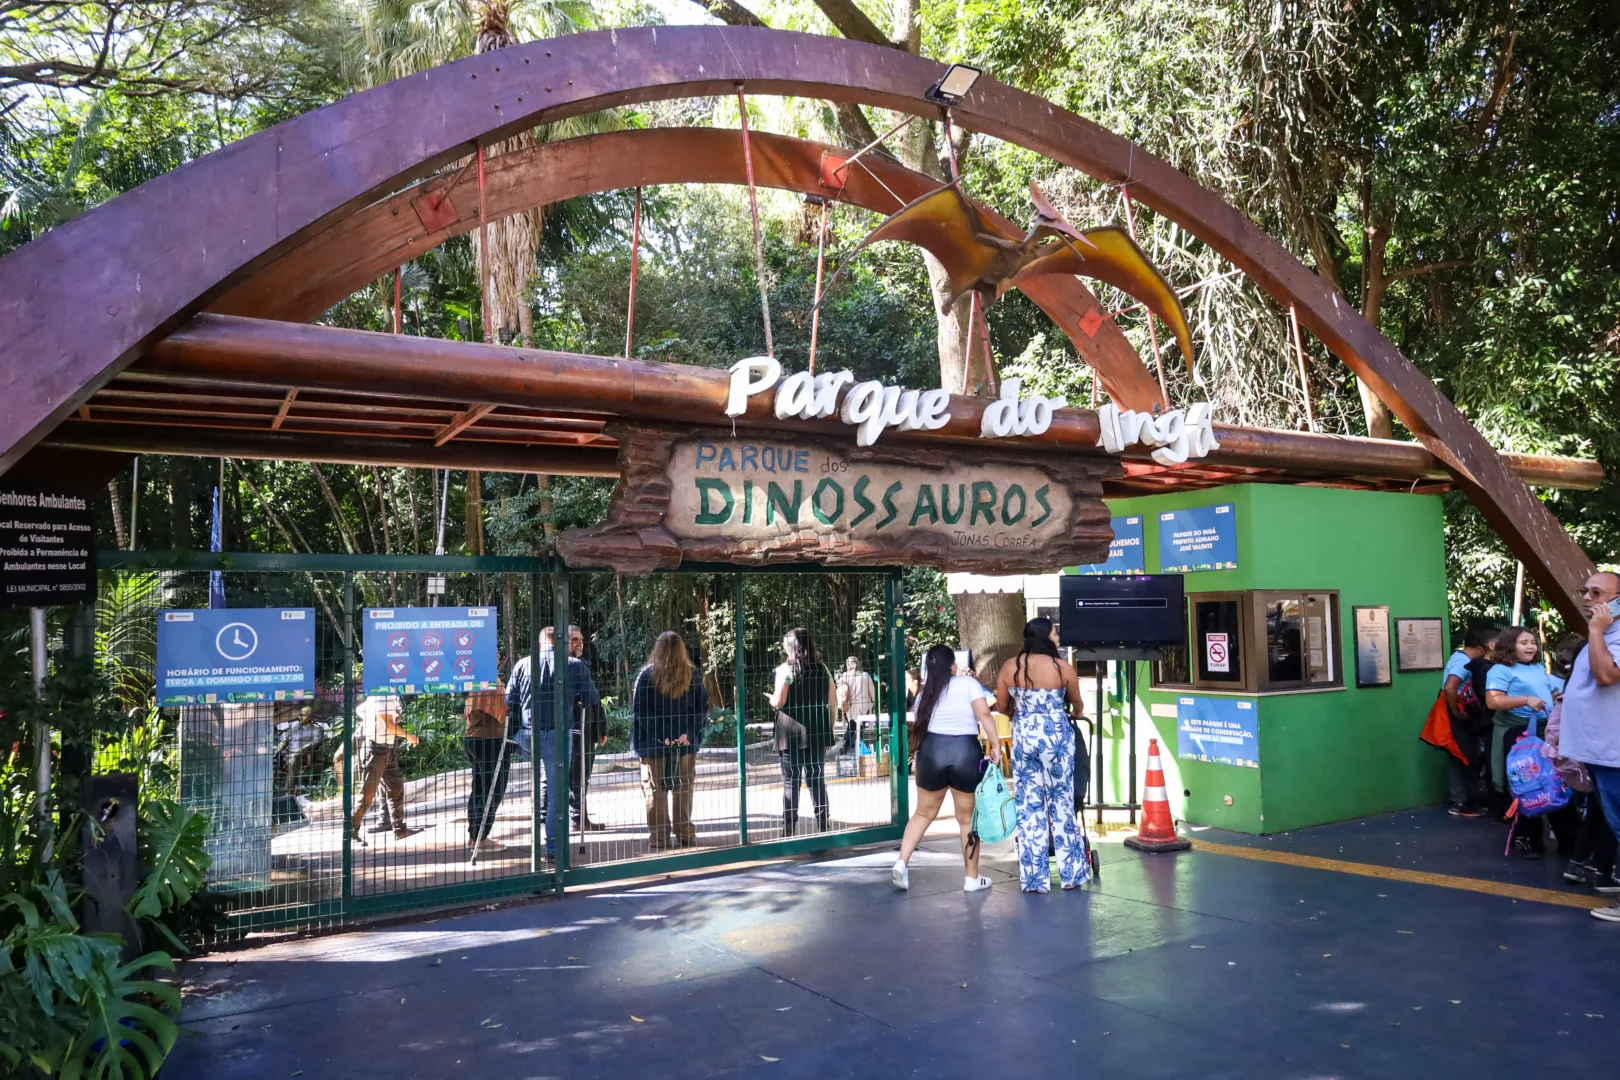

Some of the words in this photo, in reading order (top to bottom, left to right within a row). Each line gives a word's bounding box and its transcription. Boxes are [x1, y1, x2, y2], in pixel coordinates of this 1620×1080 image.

[725, 356, 951, 447] Parque
[979, 377, 1067, 438] do
[695, 441, 811, 474] PARQUE
[820, 456, 851, 473] dos
[39, 492, 86, 510] Ambulantes
[695, 474, 1053, 531] DINOSSAUROS
[14, 521, 51, 529] Reservado
[68, 523, 91, 531] Acesso
[1173, 530, 1193, 539] PARQUE
[1193, 529, 1202, 537] DO
[1202, 526, 1217, 535] INGÁ
[19, 534, 28, 542] de
[30, 534, 64, 543] Visitantes
[1195, 535, 1220, 544] ADRIANO
[0, 547, 28, 556] Proibida
[36, 547, 79, 556] Permanência
[1179, 544, 1192, 552] JOSÉ
[1192, 542, 1213, 551] VALENTE
[4, 561, 46, 570] Ambulantes
[68, 561, 86, 570] Local
[18, 584, 51, 592] MUNICIPAL
[375, 621, 420, 631] PROIBIDO
[421, 621, 428, 629] A
[430, 620, 469, 629] ENTRADA
[470, 619, 485, 628] DE:
[167, 667, 209, 676] HORÁRIO
[212, 666, 223, 674] DE
[225, 665, 302, 674] FUNCIONAMENTO:
[165, 678, 194, 686] TERÇA
[206, 676, 251, 685] DOMINGO
[253, 674, 272, 682] 8:00
[281, 673, 303, 681] 17:00
[453, 674, 476, 682] PLANTAS
[1228, 722, 1241, 730] UMA
